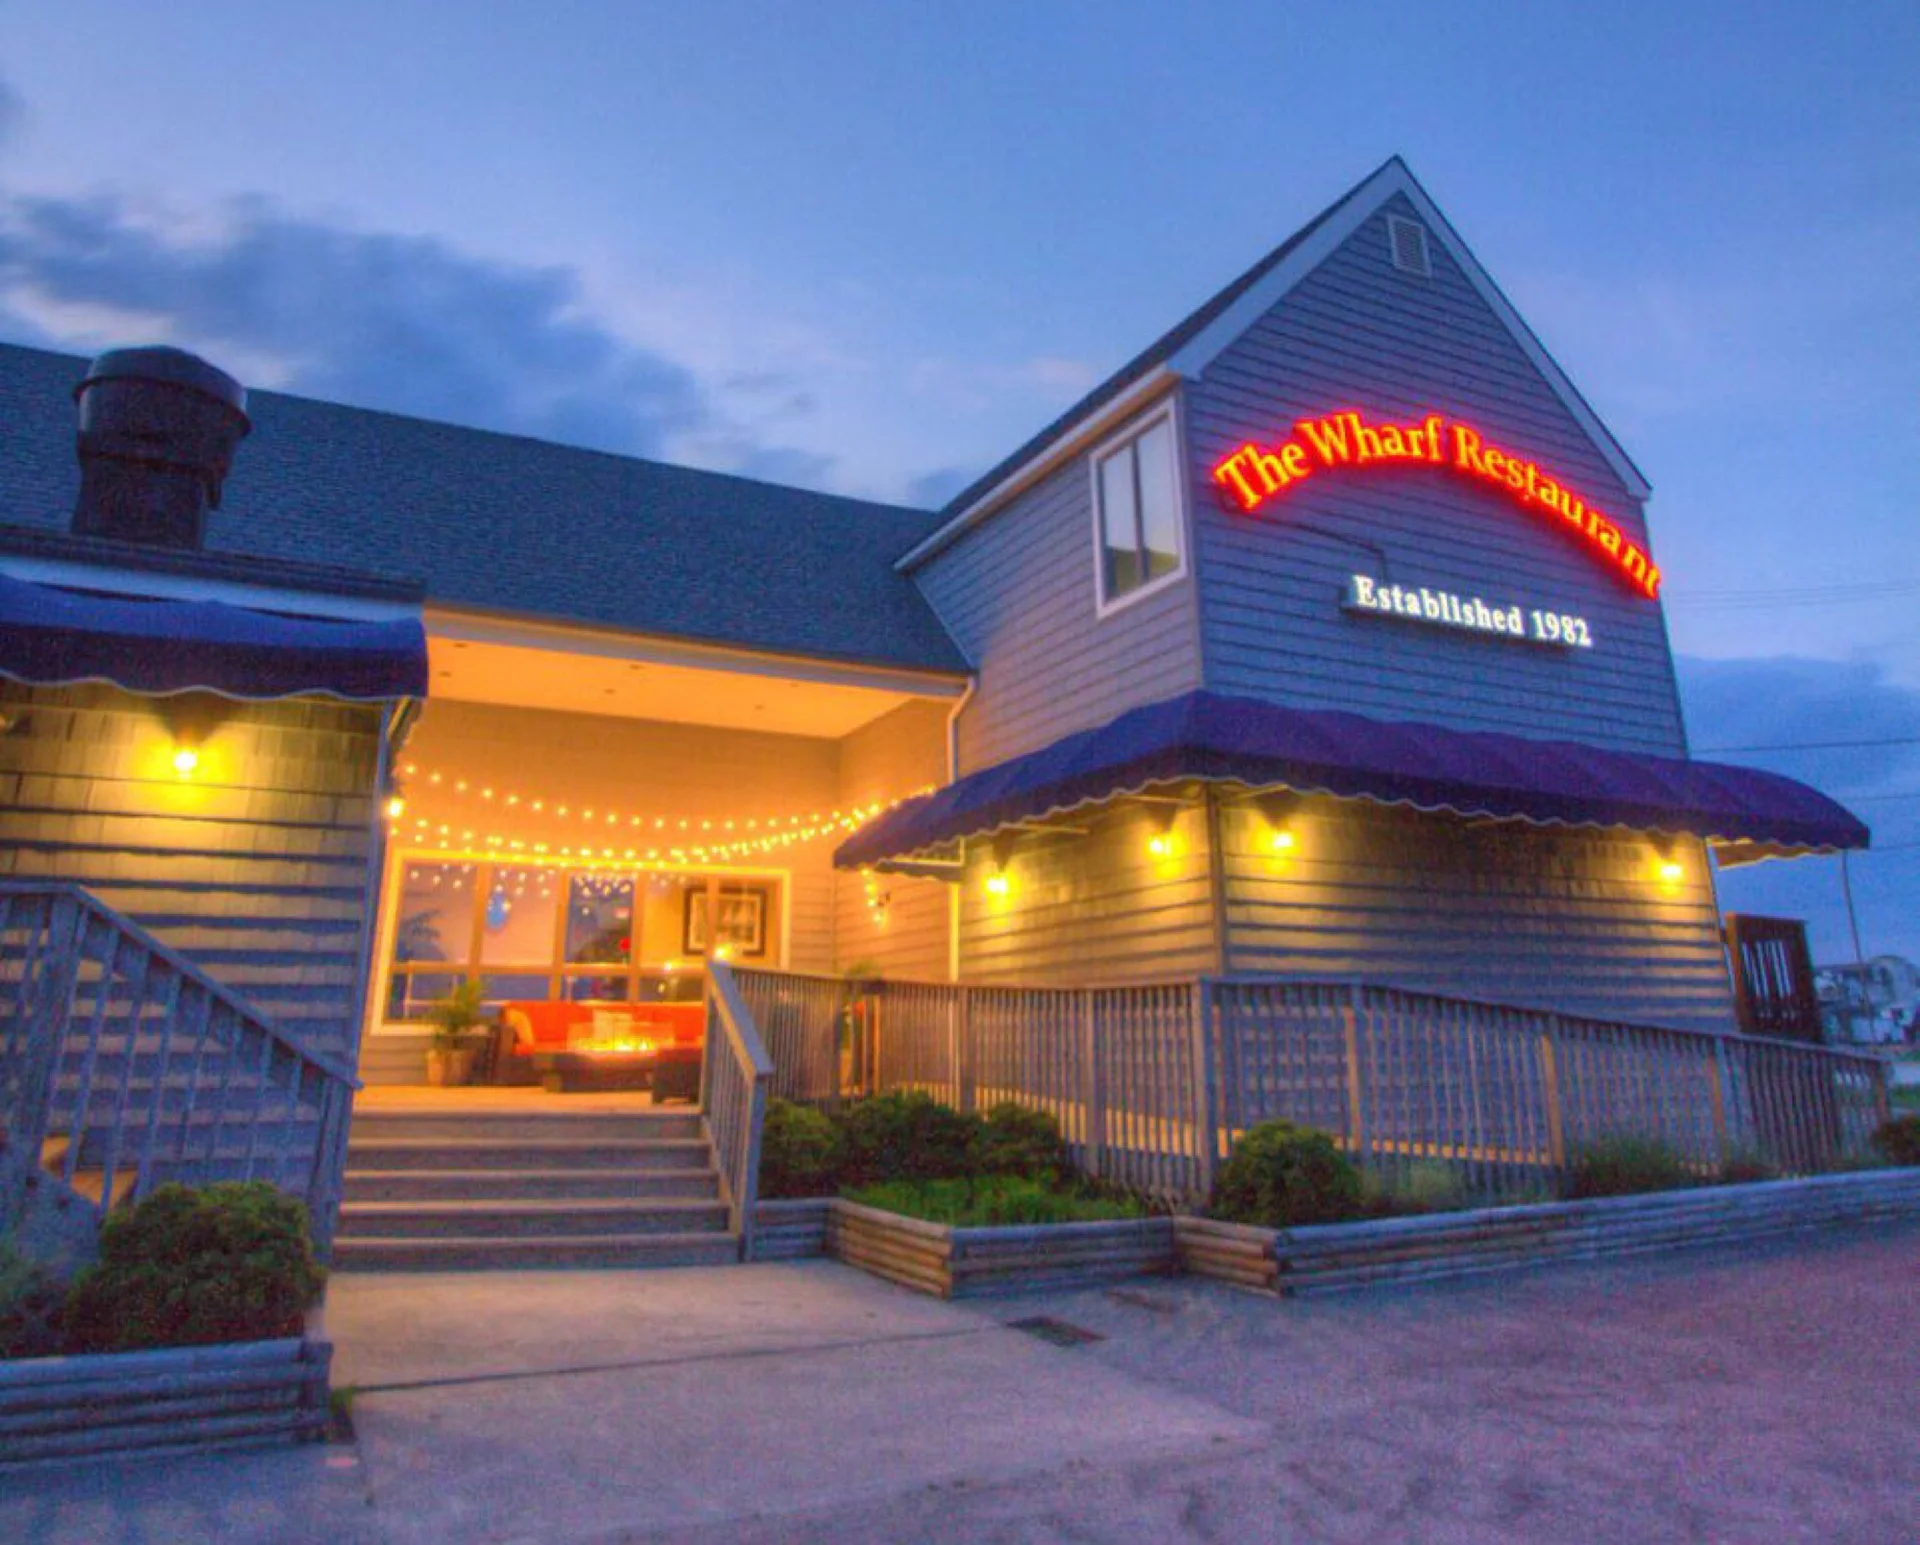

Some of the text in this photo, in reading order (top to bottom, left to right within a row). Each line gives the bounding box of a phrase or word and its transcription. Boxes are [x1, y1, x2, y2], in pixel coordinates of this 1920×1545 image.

[1213, 411, 1660, 600] The Wharf Restaurant
[1353, 574, 1593, 648] Established 1982
